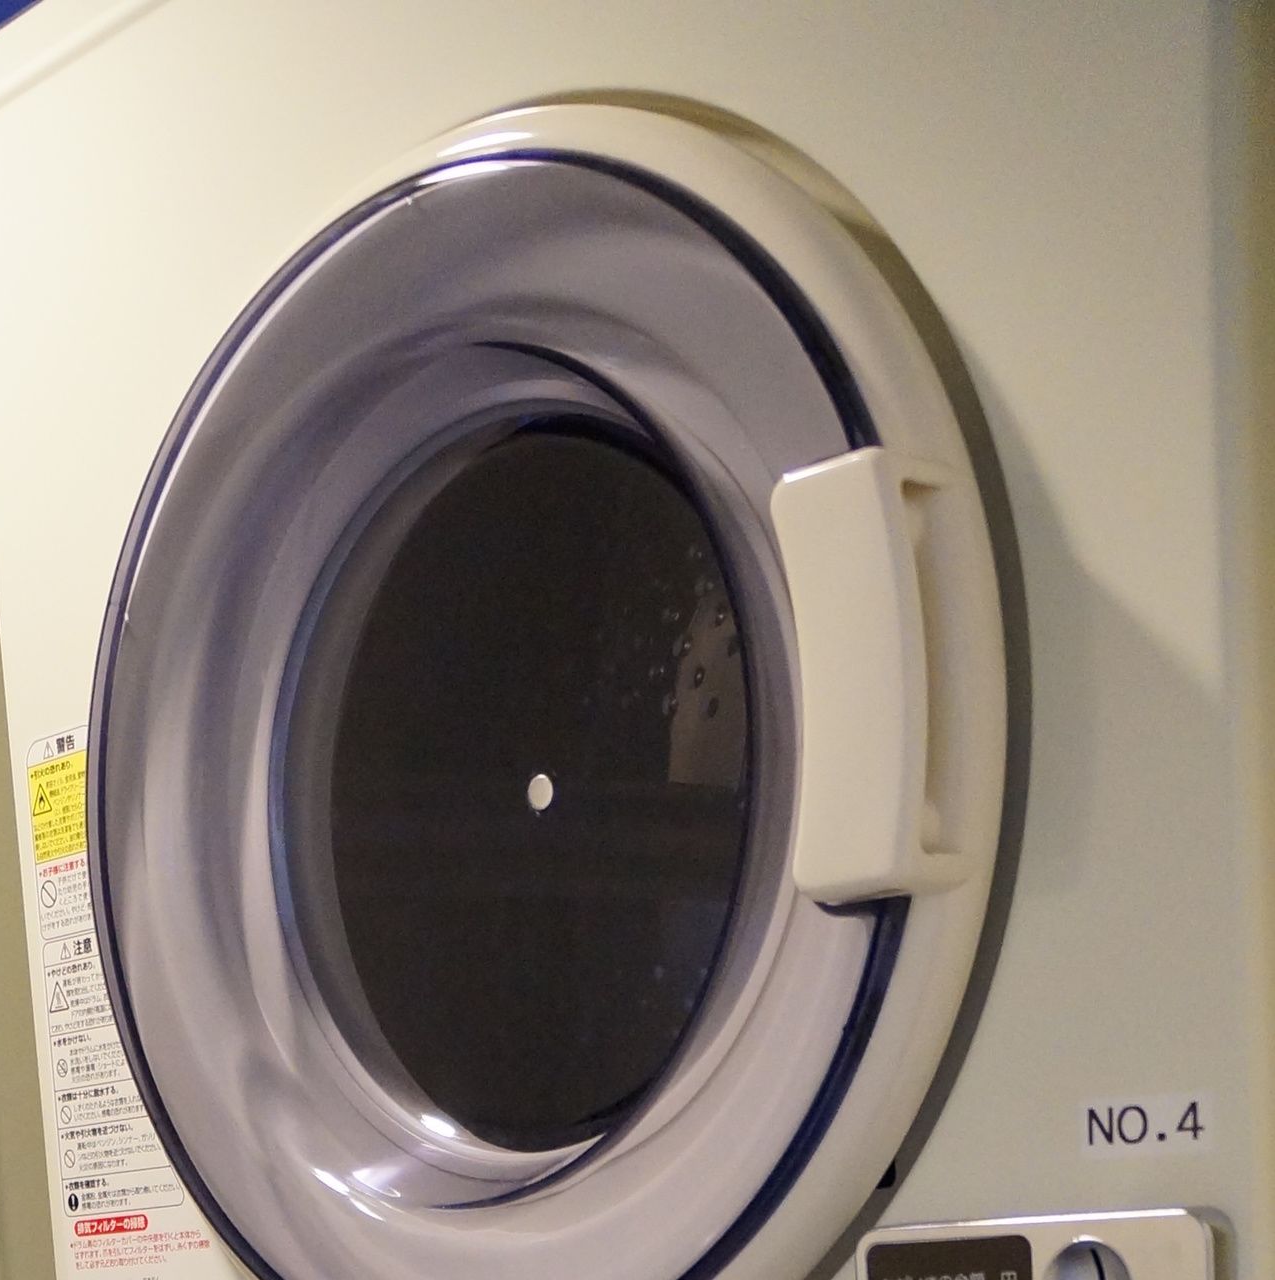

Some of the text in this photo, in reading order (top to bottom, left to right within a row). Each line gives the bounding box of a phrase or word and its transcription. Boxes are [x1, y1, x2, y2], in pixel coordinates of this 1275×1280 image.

[56, 736, 75, 753] 警告
[74, 938, 92, 955] 注意
[1088, 1101, 1205, 1146] NO.4
